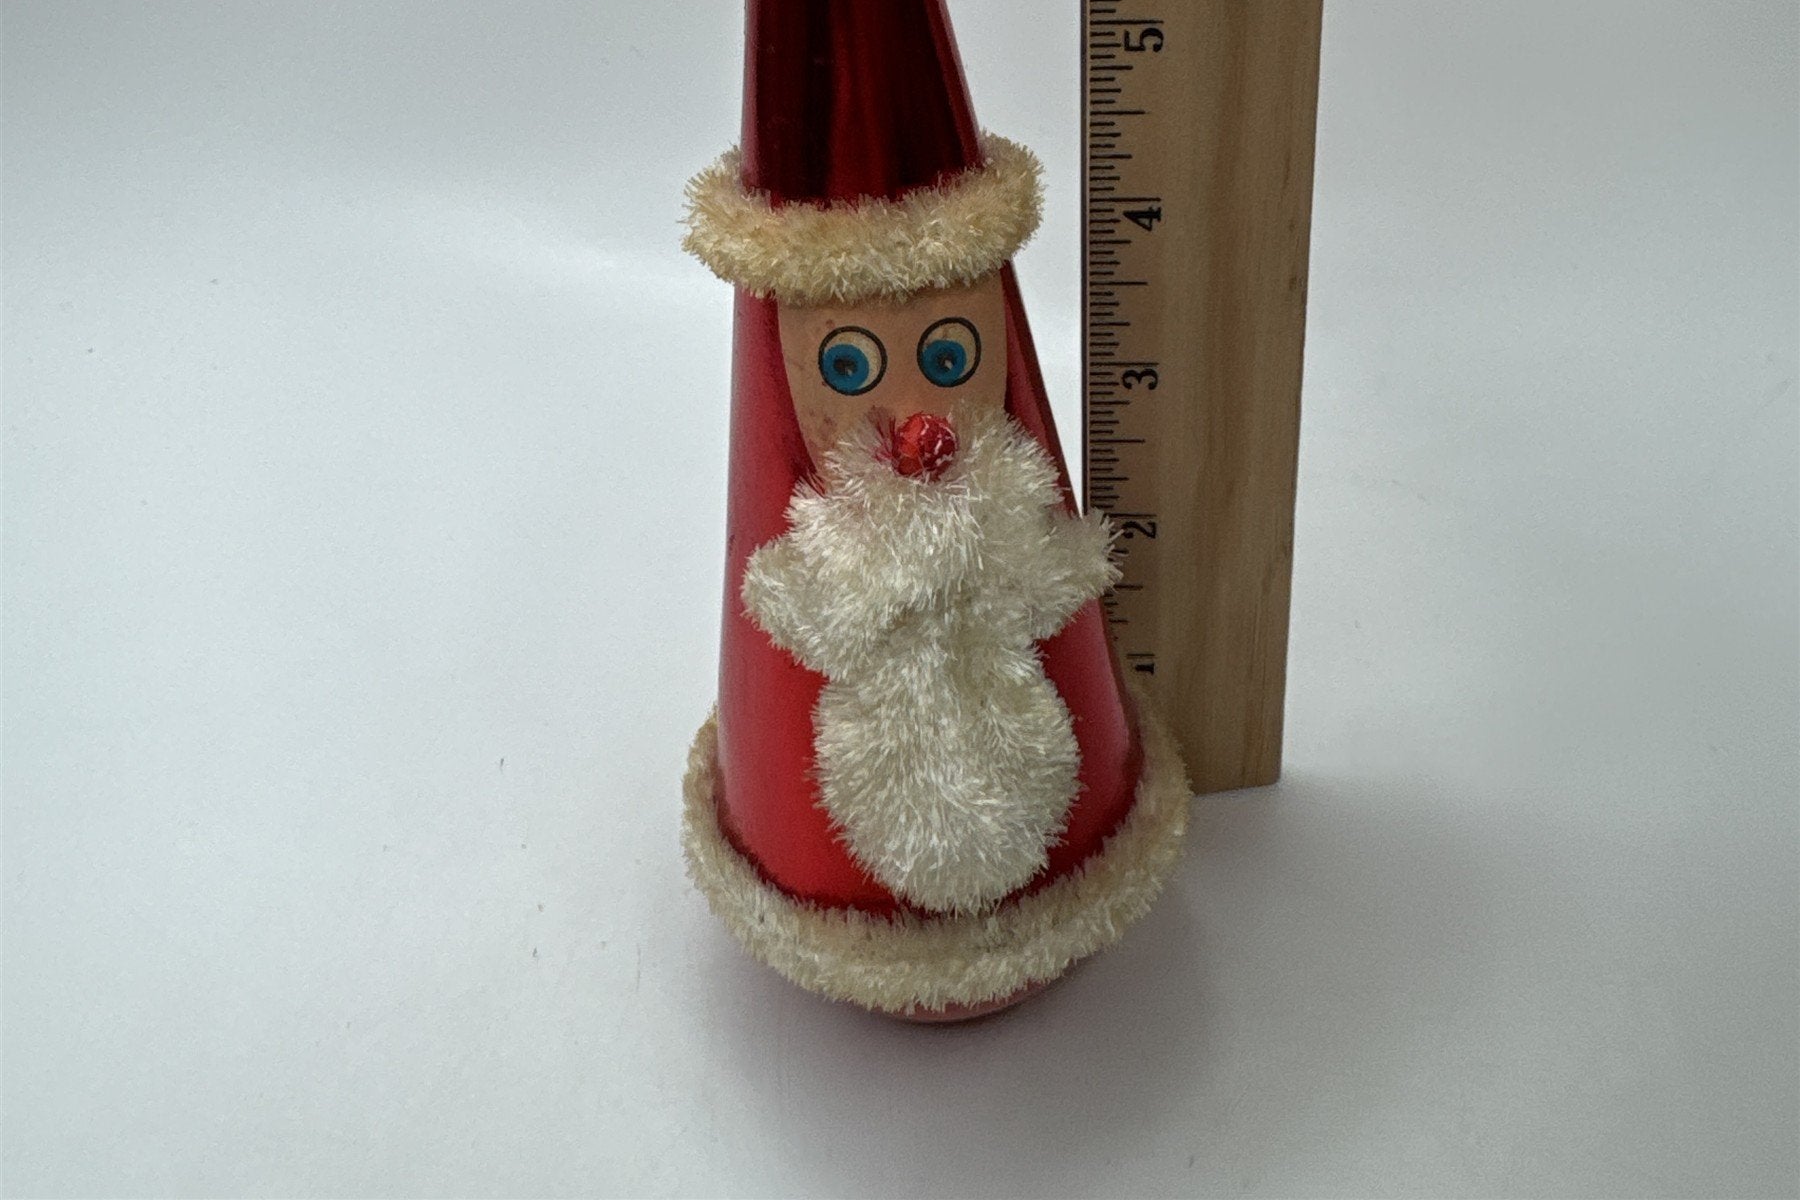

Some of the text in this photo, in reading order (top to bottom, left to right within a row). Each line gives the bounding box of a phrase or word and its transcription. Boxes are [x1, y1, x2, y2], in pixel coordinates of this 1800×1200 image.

[1123, 27, 1164, 53] 5
[1122, 206, 1162, 232] 4
[1121, 368, 1159, 390] 3
[1121, 521, 1157, 539] 2
